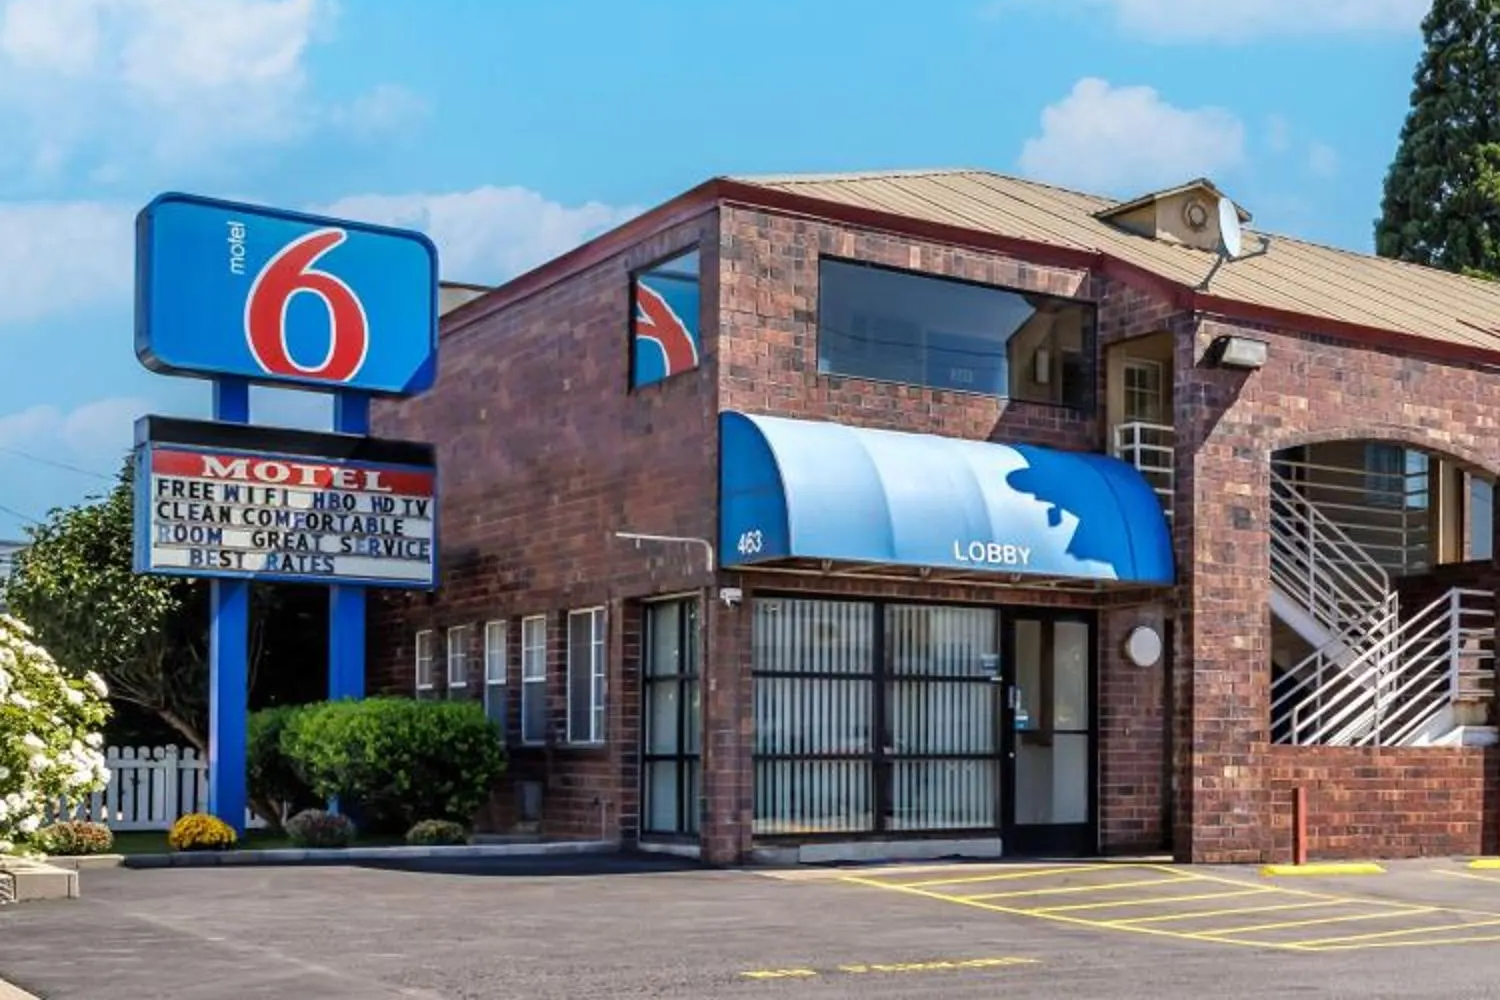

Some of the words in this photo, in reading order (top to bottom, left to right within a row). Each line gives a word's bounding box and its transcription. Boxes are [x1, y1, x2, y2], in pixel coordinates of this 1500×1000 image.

[226, 221, 246, 275] motel
[243, 227, 370, 383] 6
[201, 455, 393, 492] MOTEL
[158, 480, 215, 501] FREE
[313, 492, 356, 511] HBO
[157, 501, 231, 523] CLEAN
[242, 507, 405, 536] COMFORTABLE
[160, 523, 222, 545] ROOM
[251, 531, 323, 553] GREAT
[341, 535, 431, 561] SERVICE
[953, 540, 1031, 565] LOBBY
[190, 548, 246, 569] BEST
[265, 552, 335, 573] RATES
